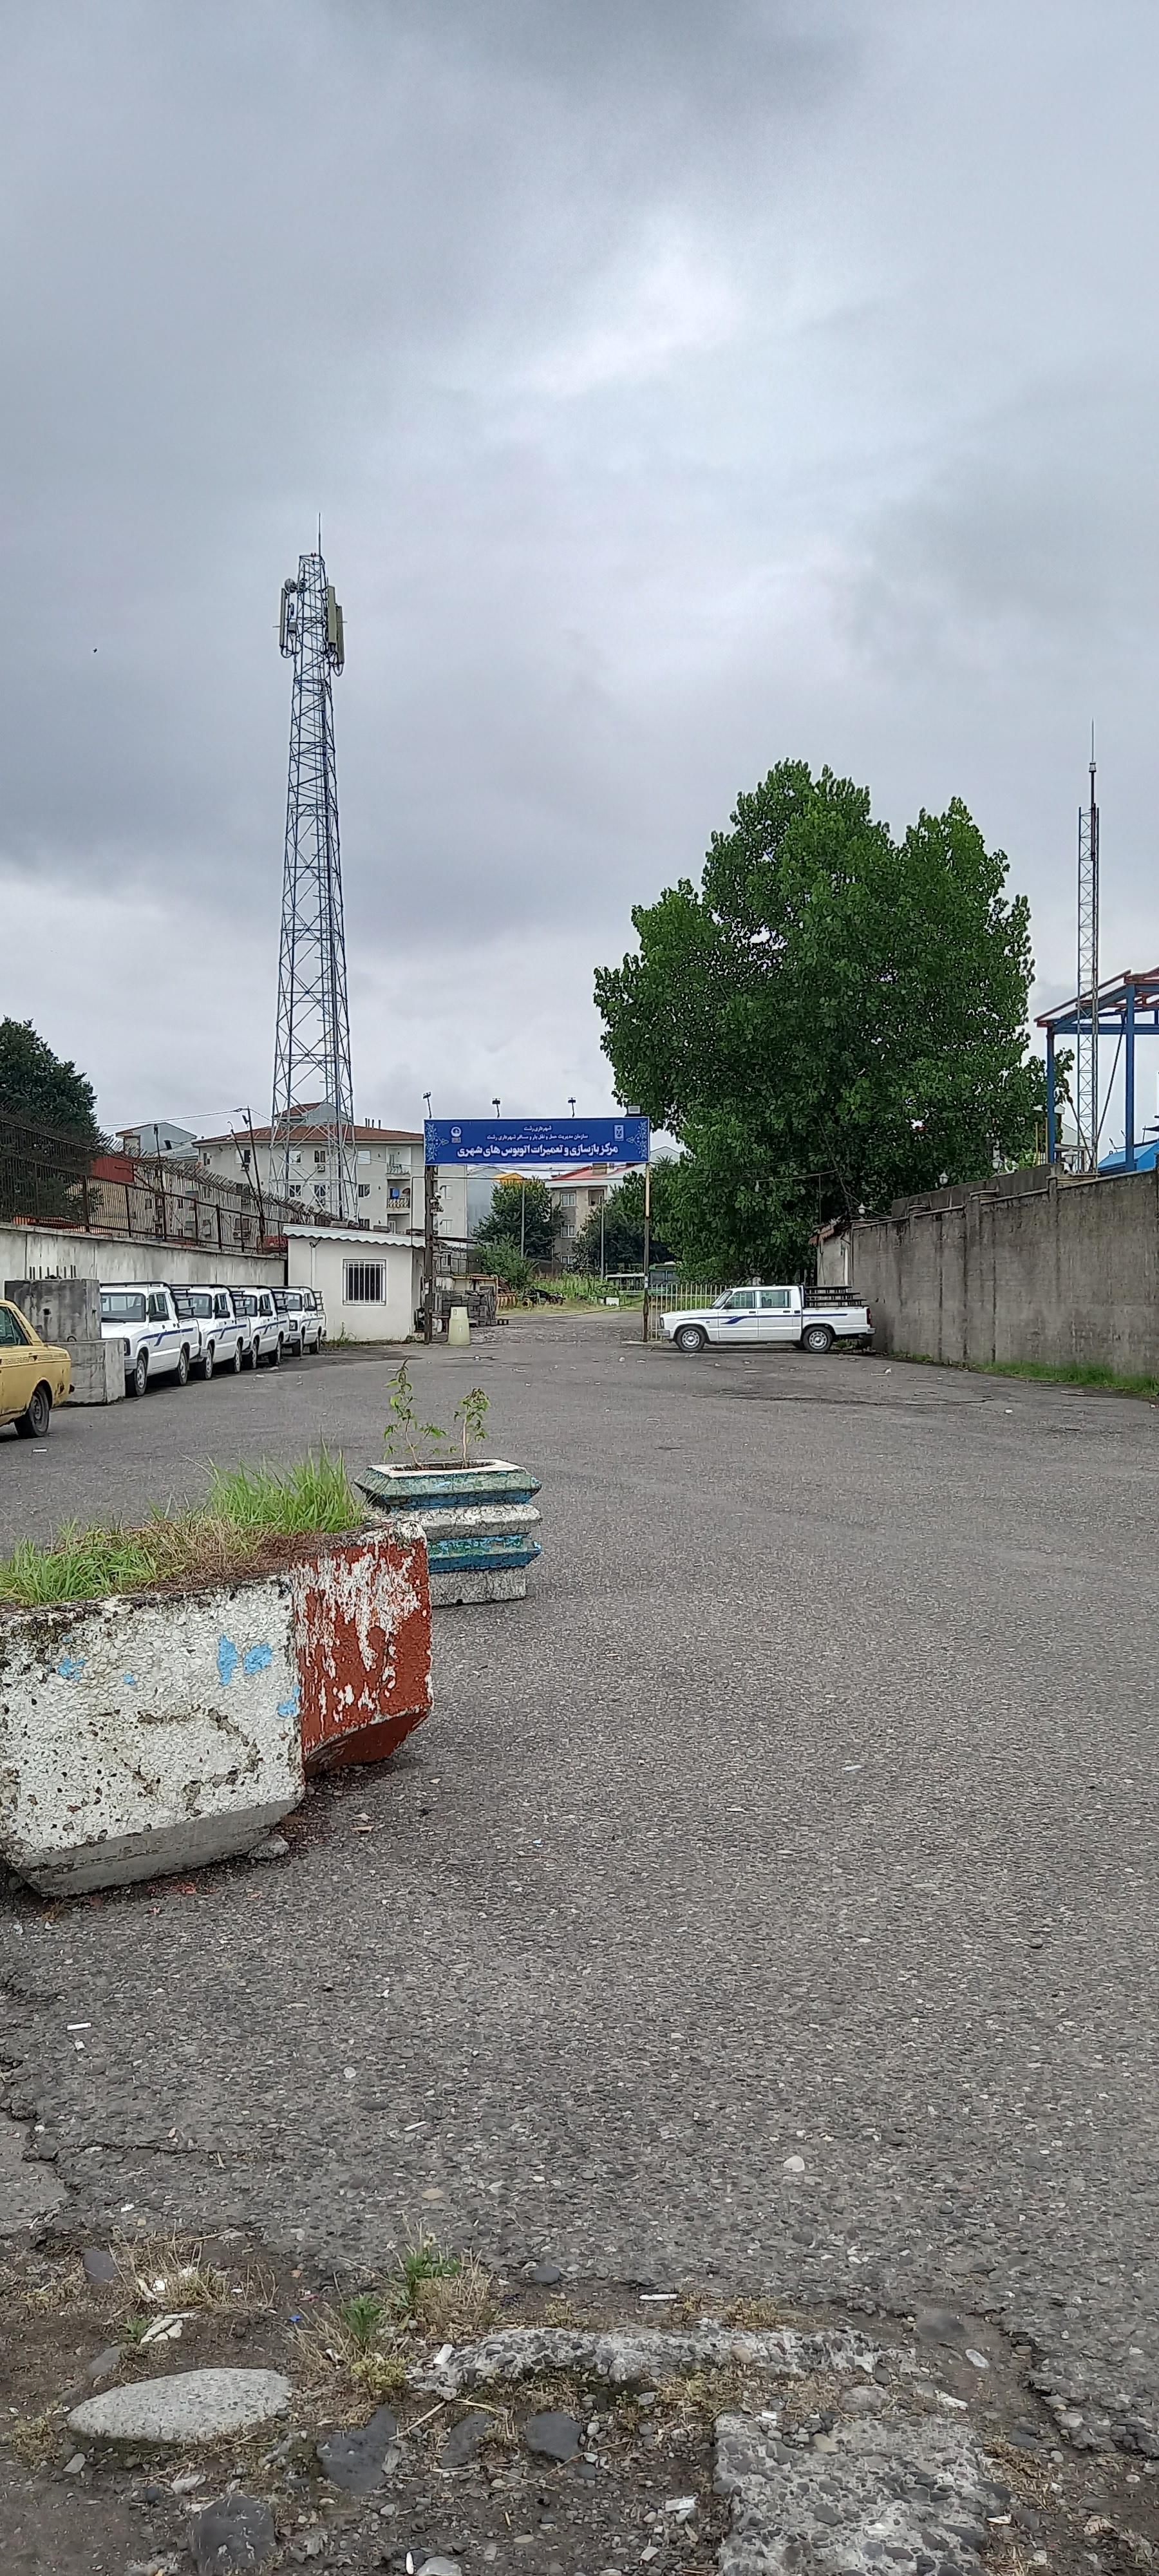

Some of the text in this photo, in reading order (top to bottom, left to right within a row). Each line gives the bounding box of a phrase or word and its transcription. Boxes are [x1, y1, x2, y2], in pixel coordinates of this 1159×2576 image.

[457, 1142, 618, 1157] مرکز بازسازی و تعمیرات اتوبوس های شهری
